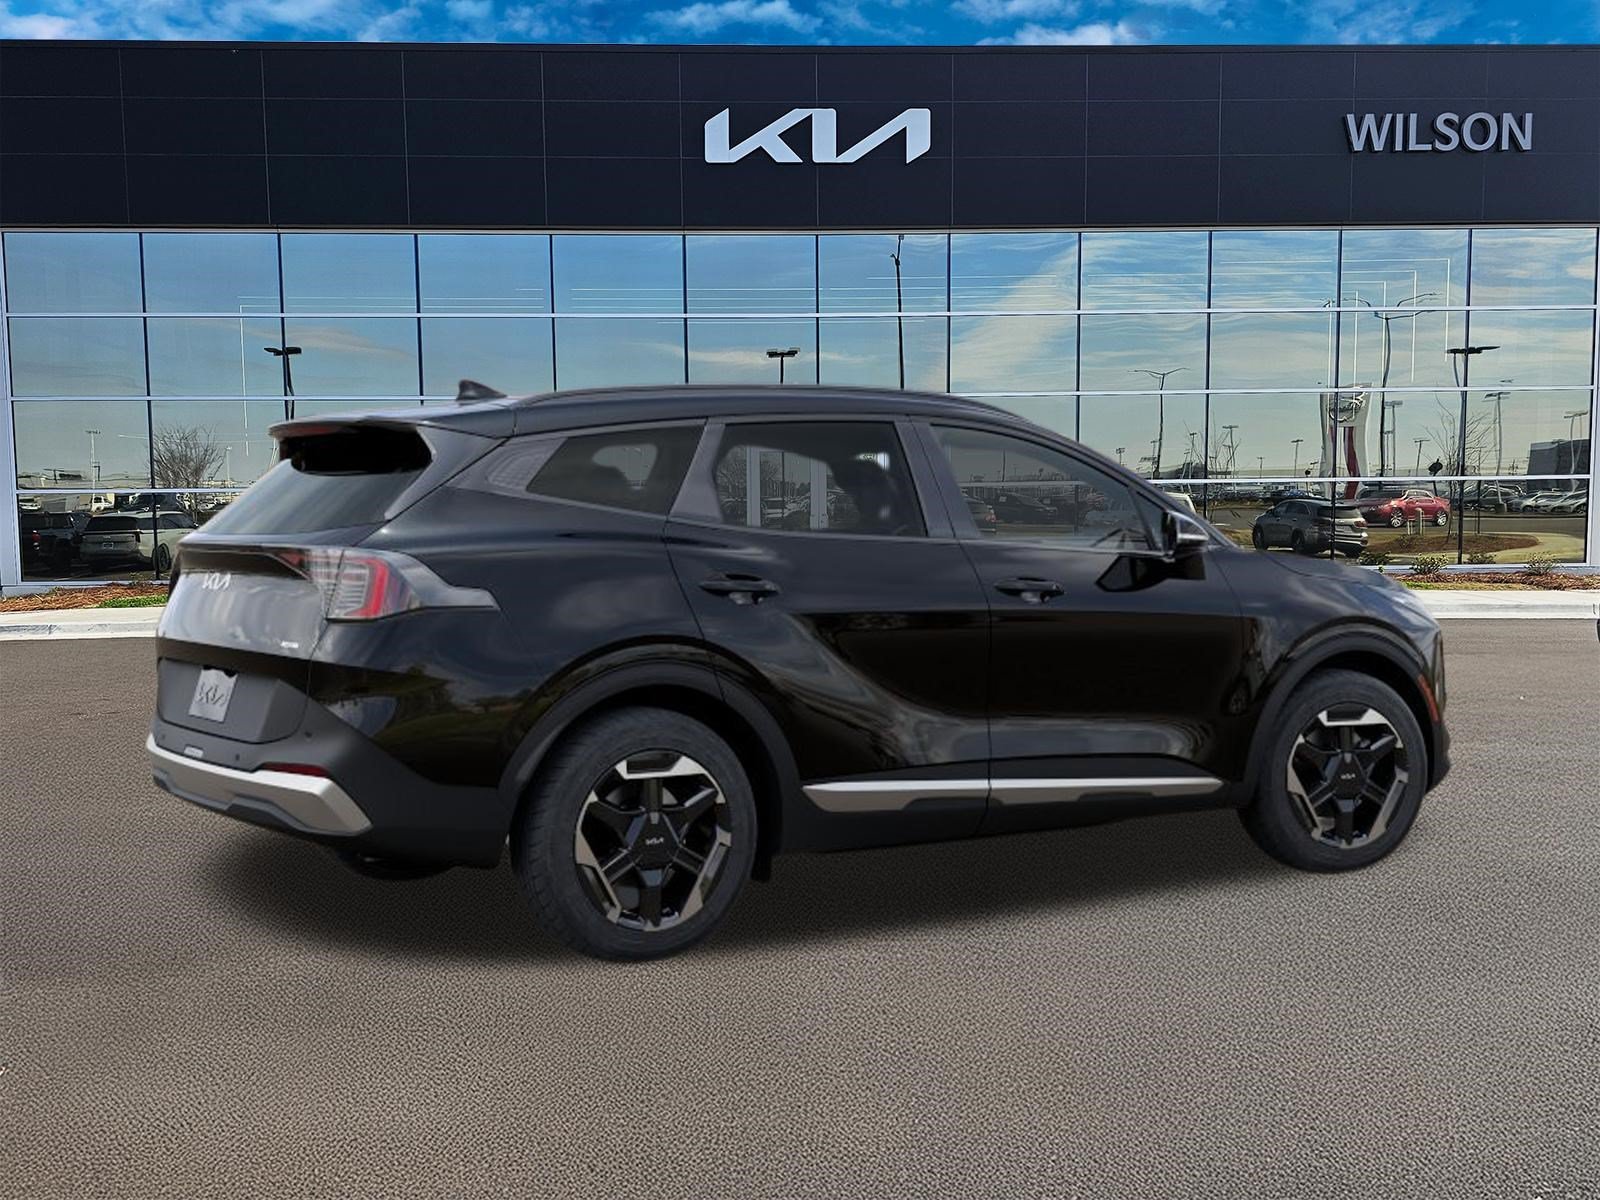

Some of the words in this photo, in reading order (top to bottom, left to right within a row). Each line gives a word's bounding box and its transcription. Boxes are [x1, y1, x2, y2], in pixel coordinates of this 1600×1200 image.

[704, 107, 931, 164] KIA
[1345, 112, 1534, 152] WILSON
[202, 573, 231, 590] KIA
